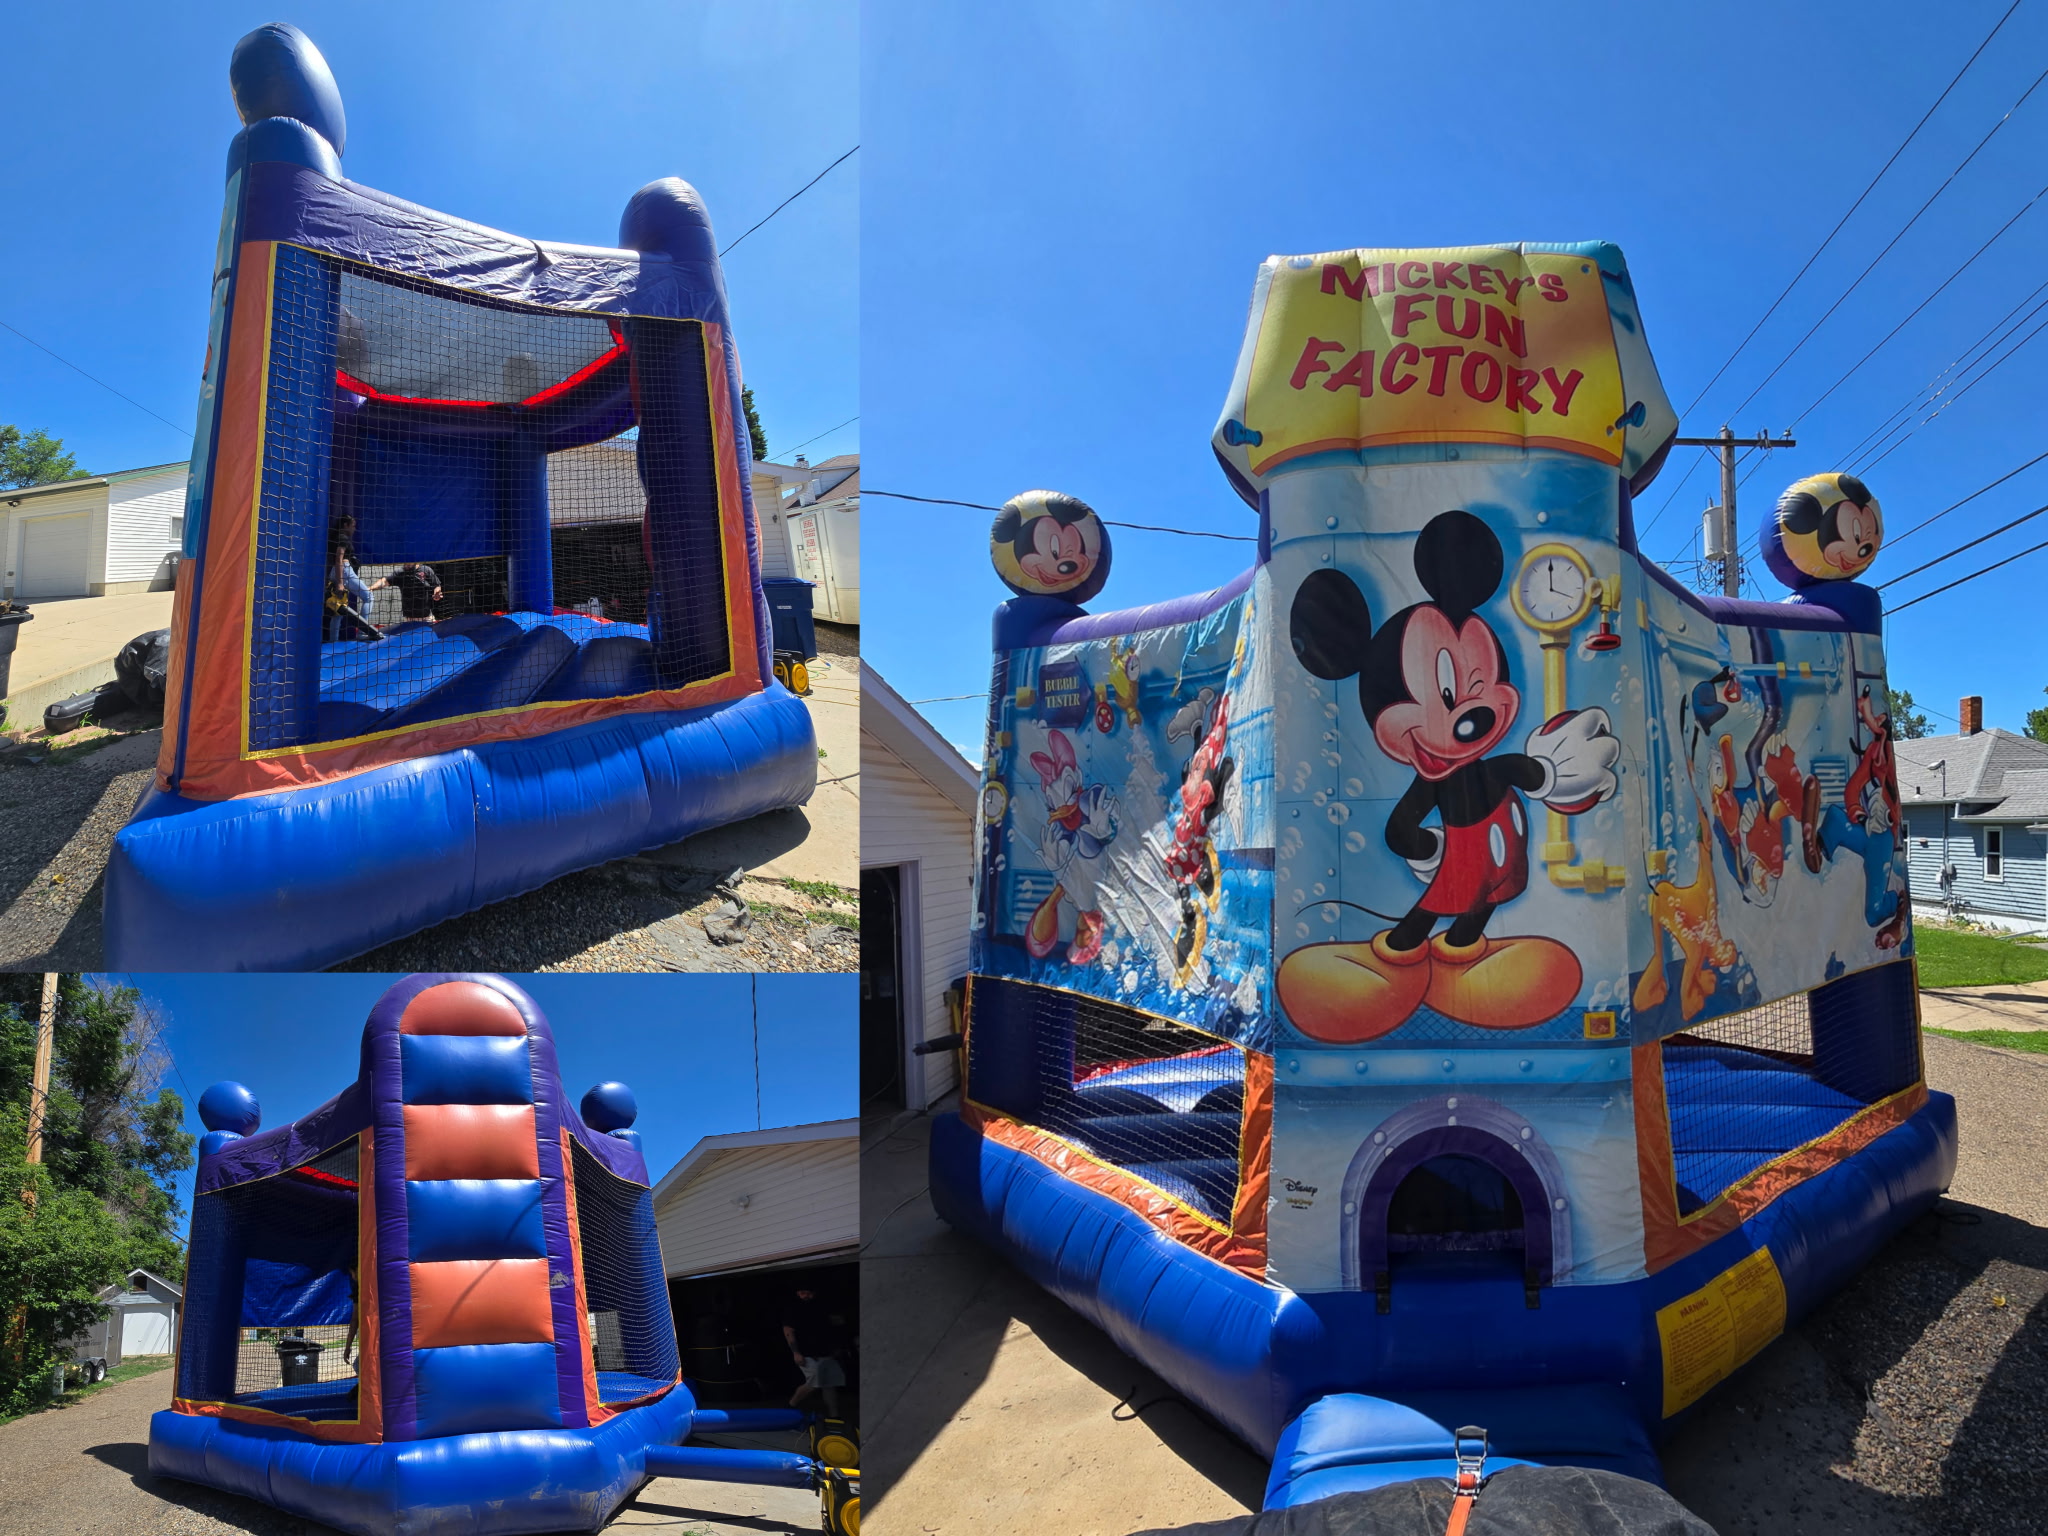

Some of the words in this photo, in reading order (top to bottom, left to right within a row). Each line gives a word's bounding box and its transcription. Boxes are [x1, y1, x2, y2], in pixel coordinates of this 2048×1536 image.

[1320, 261, 1569, 306] MICKEY'S
[1391, 293, 1528, 359] FUN
[1289, 337, 1584, 416] FACTORY
[1045, 676, 1079, 692] BUBBLE
[1045, 693, 1080, 708] TESTER
[1280, 1178, 1318, 1197] Disney
[1680, 1297, 1709, 1319] WARNING
